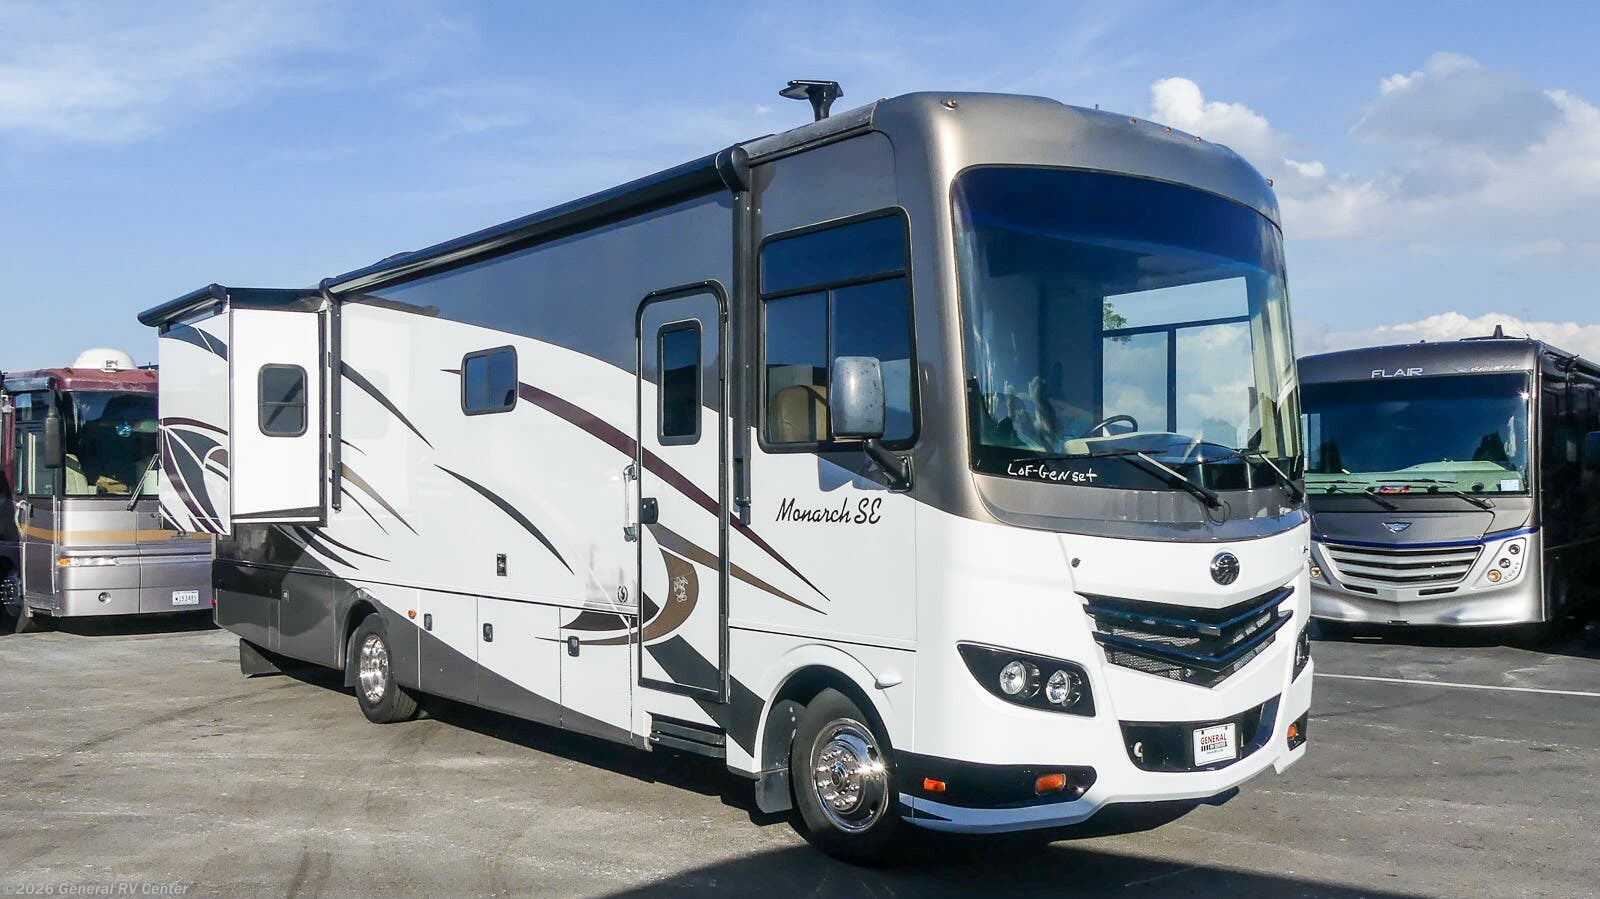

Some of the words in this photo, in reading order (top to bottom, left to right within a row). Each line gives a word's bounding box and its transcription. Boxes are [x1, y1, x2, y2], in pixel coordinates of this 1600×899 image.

[1371, 367, 1423, 379] FLAIR
[775, 497, 852, 523] Monarch
[853, 497, 882, 525] SE
[1200, 733, 1228, 746] GENERAL
